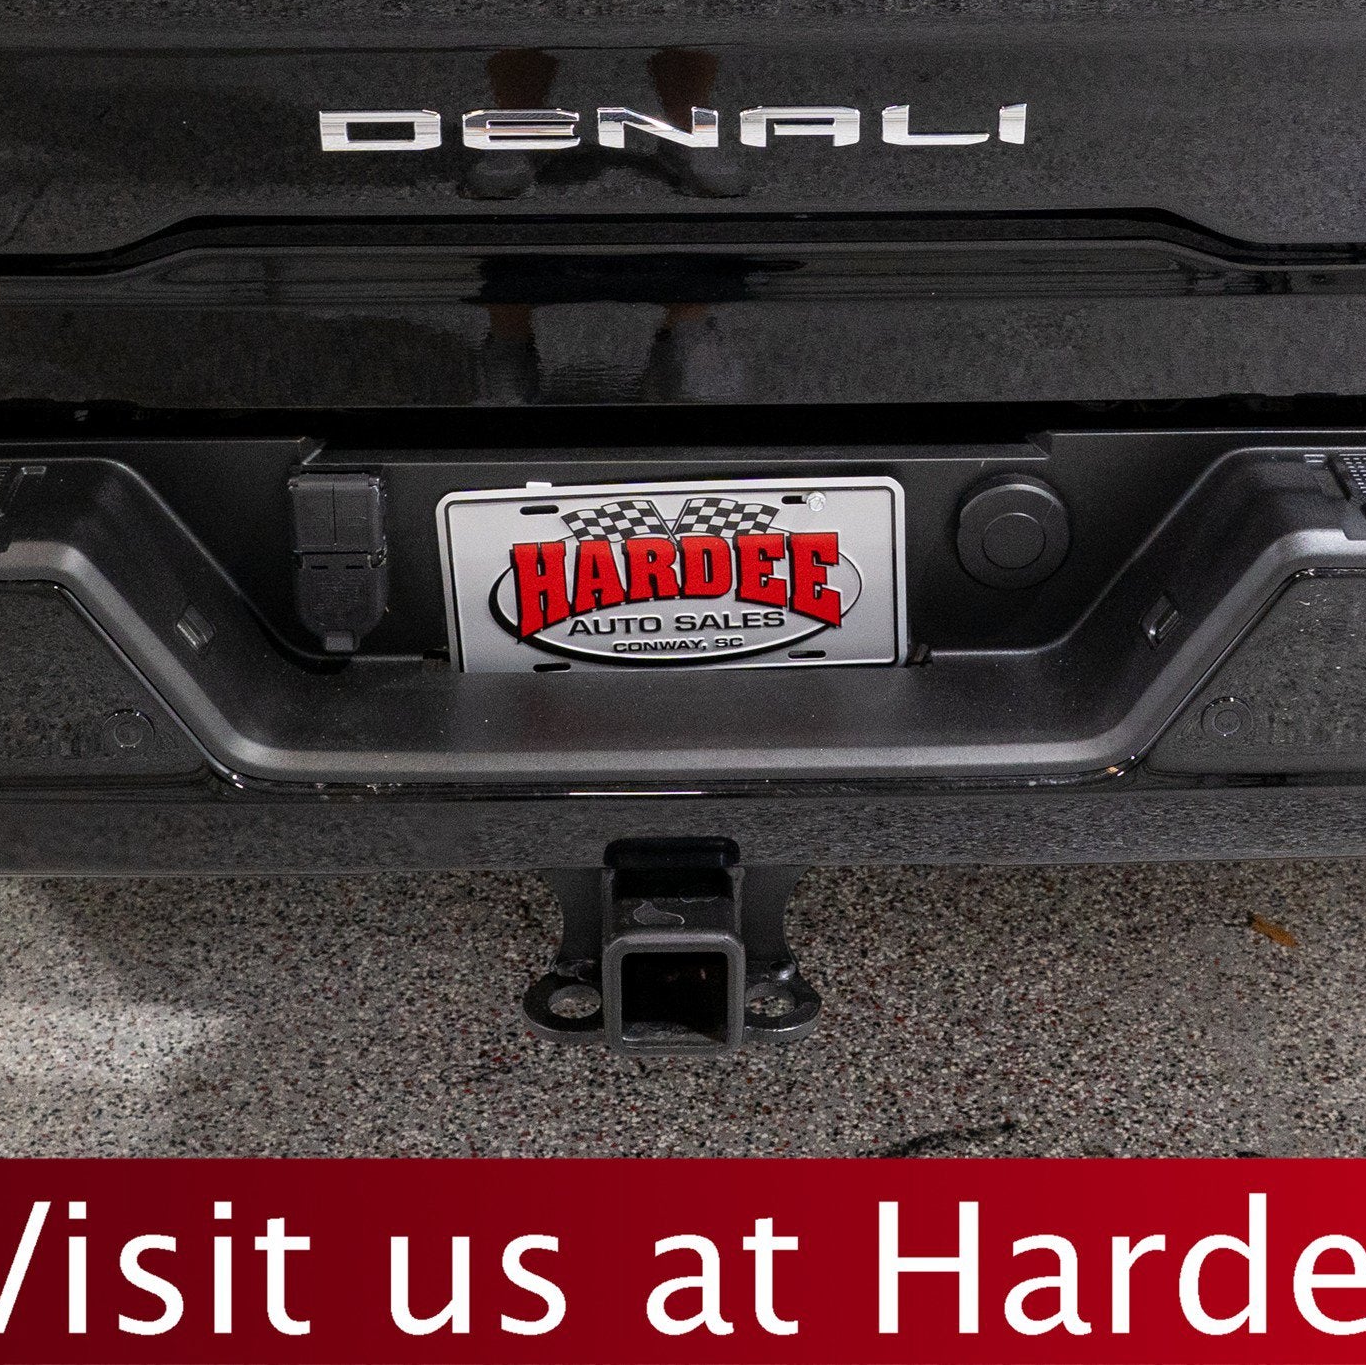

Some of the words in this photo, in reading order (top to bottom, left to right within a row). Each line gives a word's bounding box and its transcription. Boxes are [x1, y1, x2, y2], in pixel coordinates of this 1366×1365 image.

[319, 103, 1028, 152] DENALI
[511, 531, 842, 643] HARDEE
[567, 614, 663, 636] AUTO
[674, 610, 786, 632] SALES
[612, 637, 708, 653] CONWAY,
[714, 635, 744, 649] SC
